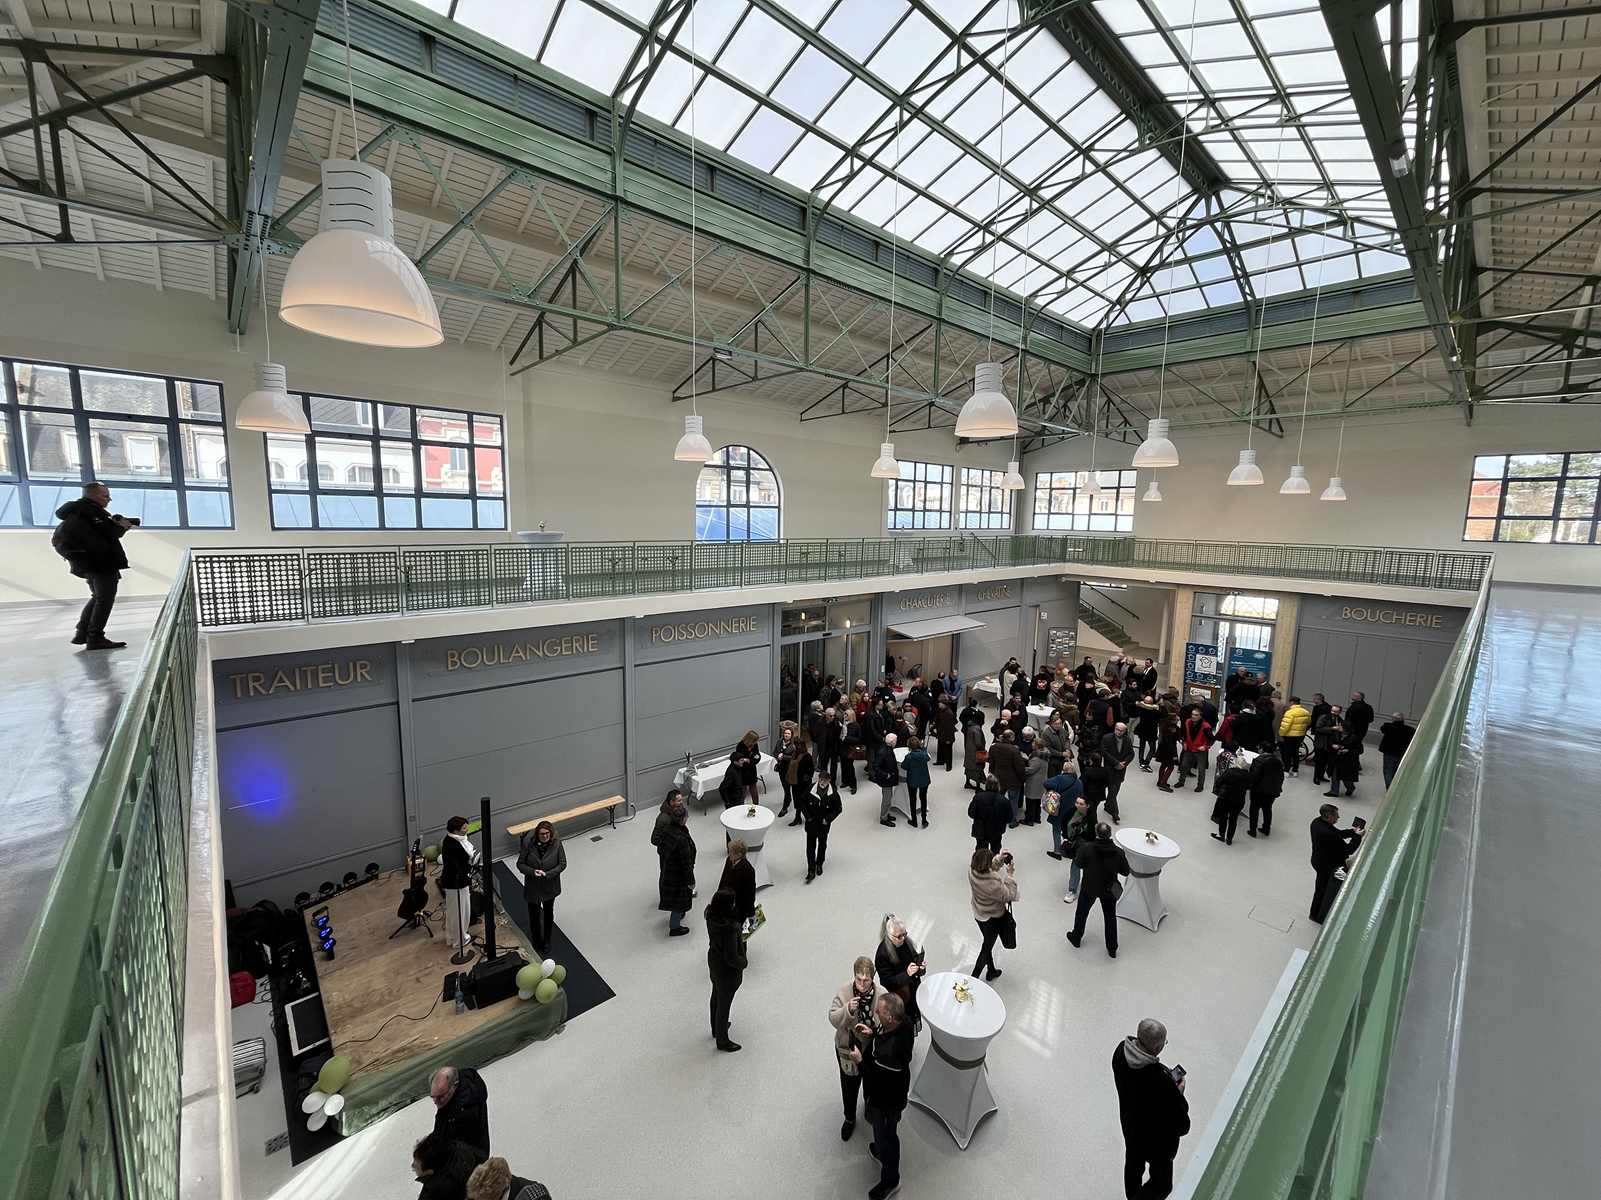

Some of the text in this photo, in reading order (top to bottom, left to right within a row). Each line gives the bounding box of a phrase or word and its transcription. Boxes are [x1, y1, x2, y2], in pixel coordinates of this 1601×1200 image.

[651, 616, 758, 643] POISSONNERIE
[1342, 606, 1442, 628] BOUCHERIE
[446, 634, 599, 671] BOULANGERIE
[229, 660, 372, 698] TRAITEUR
